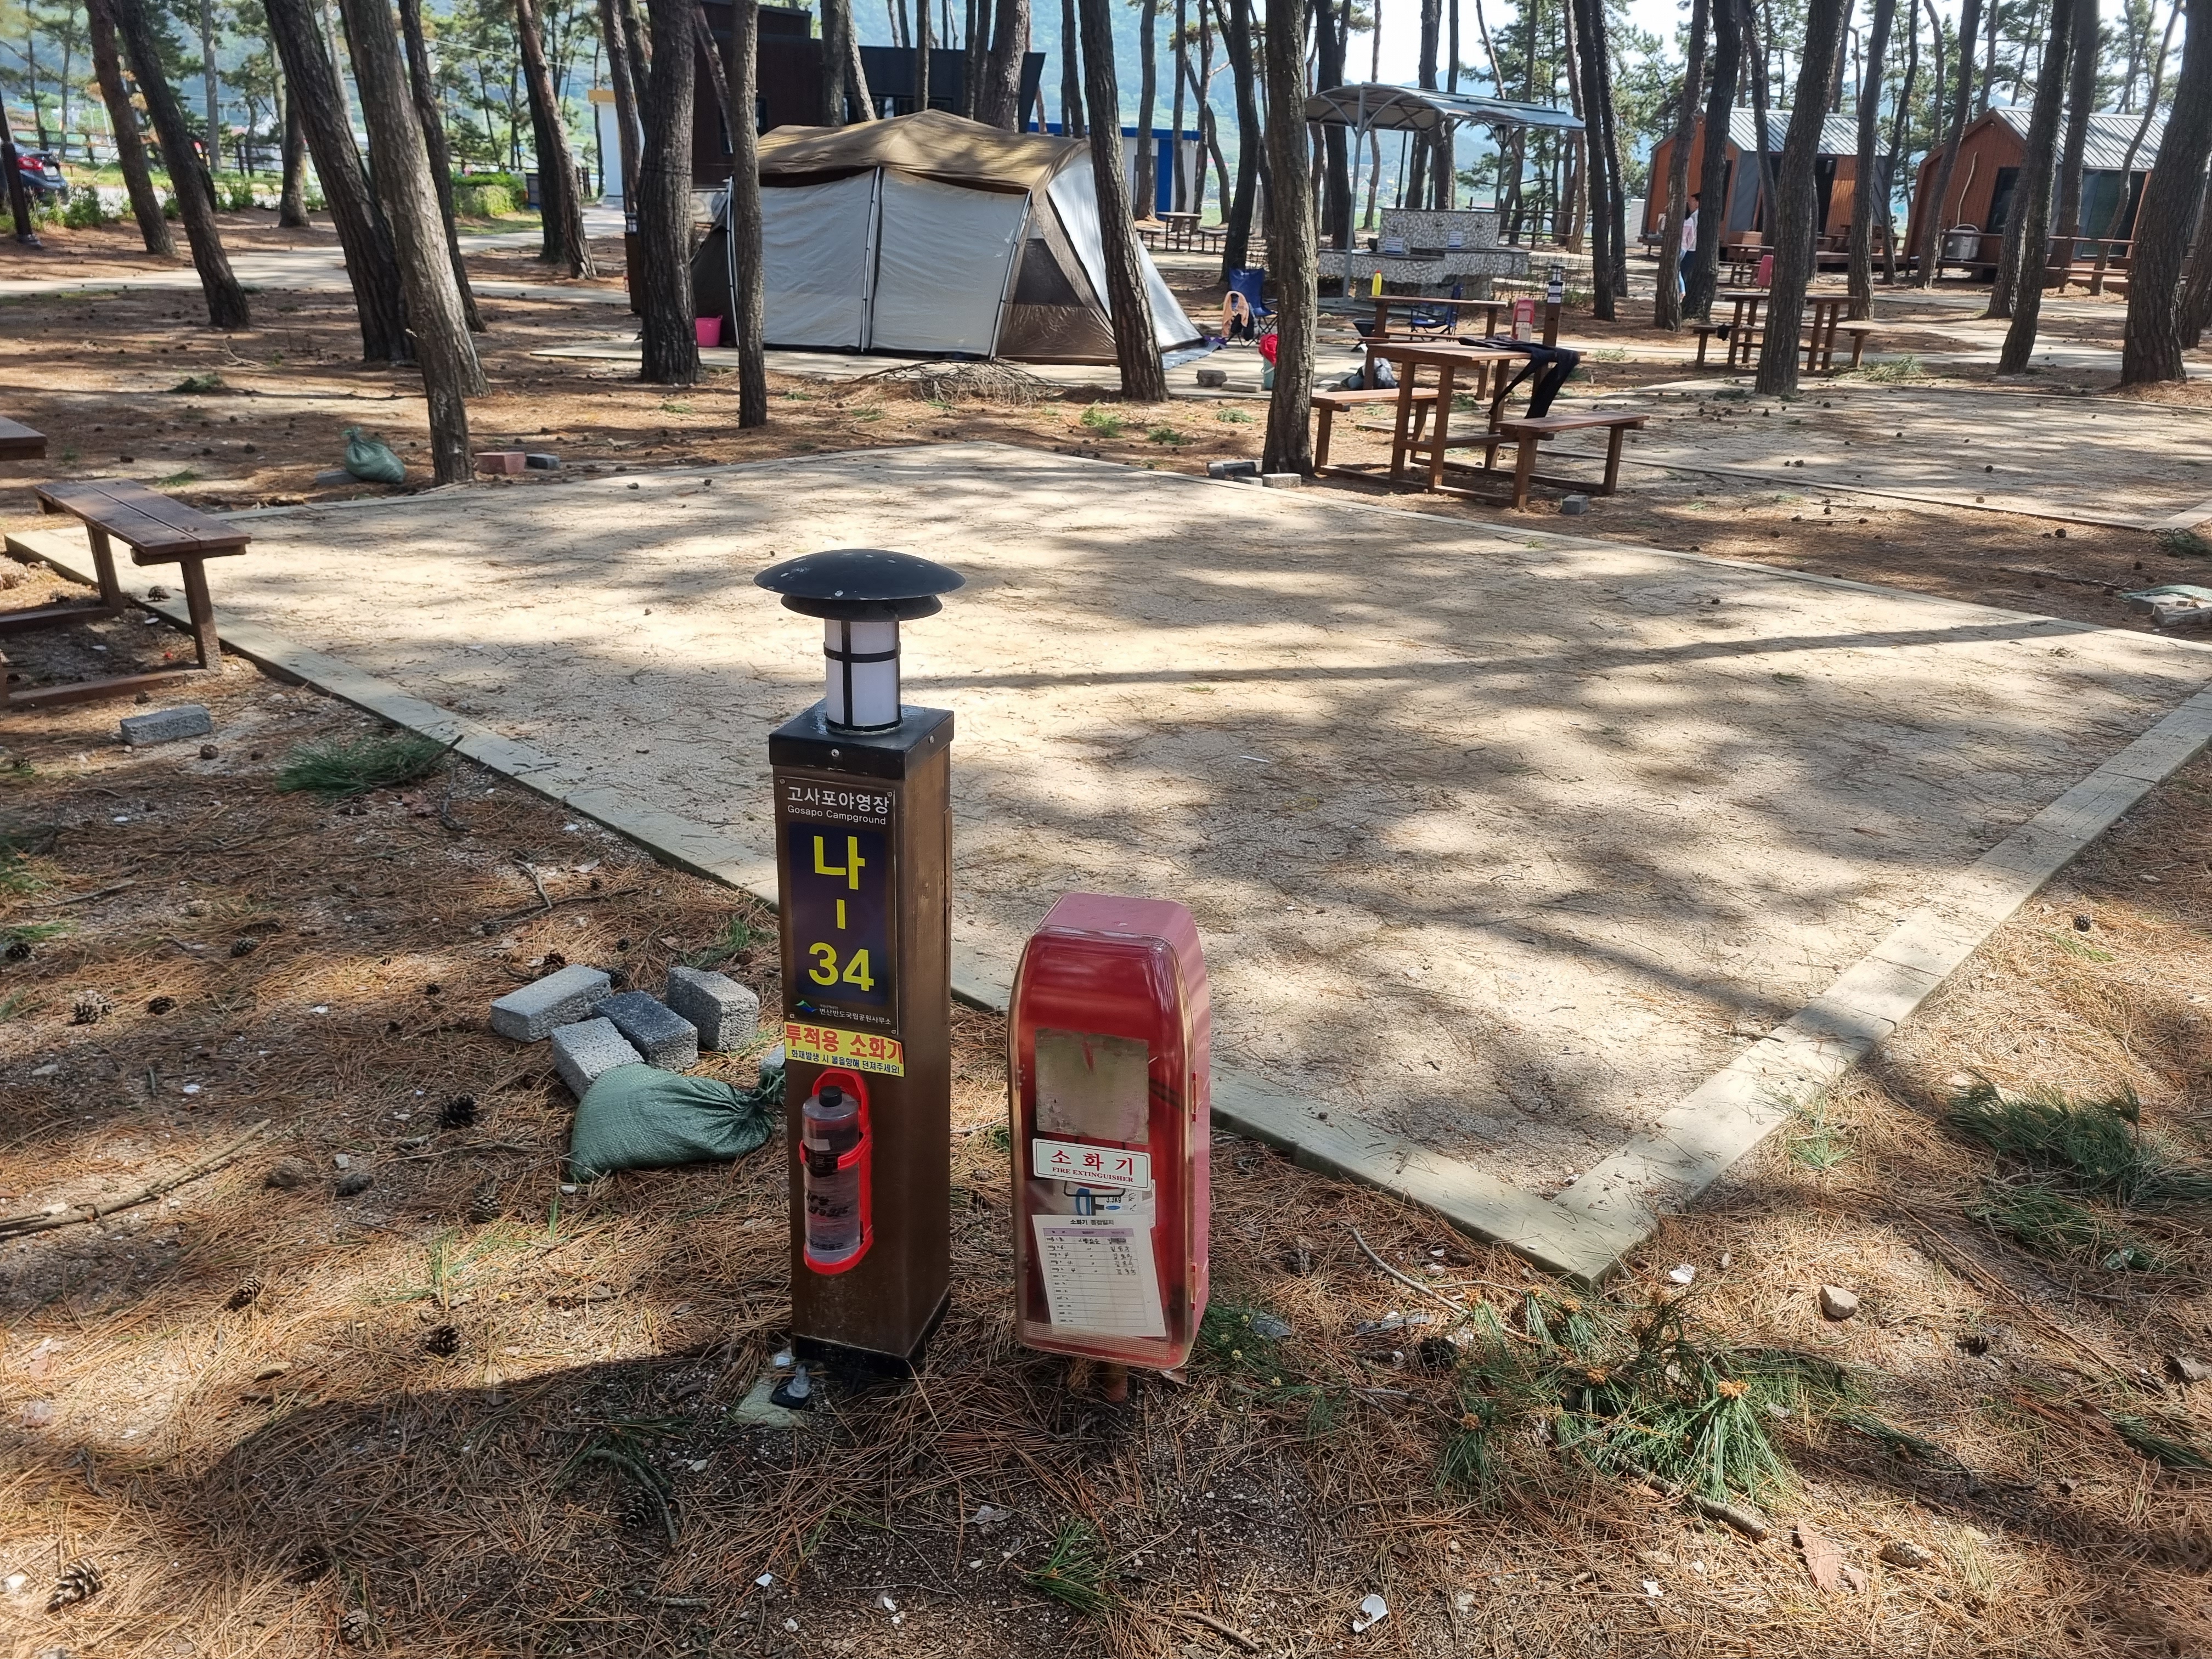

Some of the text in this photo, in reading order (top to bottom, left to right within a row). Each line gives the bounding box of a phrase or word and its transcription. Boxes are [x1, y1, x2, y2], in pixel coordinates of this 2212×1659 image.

[787, 786, 890, 814] 고사포야영장
[787, 805, 886, 825] Gosapo Campground
[814, 836, 865, 890] 나
[809, 942, 874, 991] 34
[819, 1007, 891, 1025] 변산반도국립공원사무소
[786, 1024, 903, 1064] 투척용 소화기
[791, 1049, 819, 1062] 화재발생
[822, 1054, 829, 1064] 시
[1073, 1170, 1133, 1183] EXTINGUISHER
